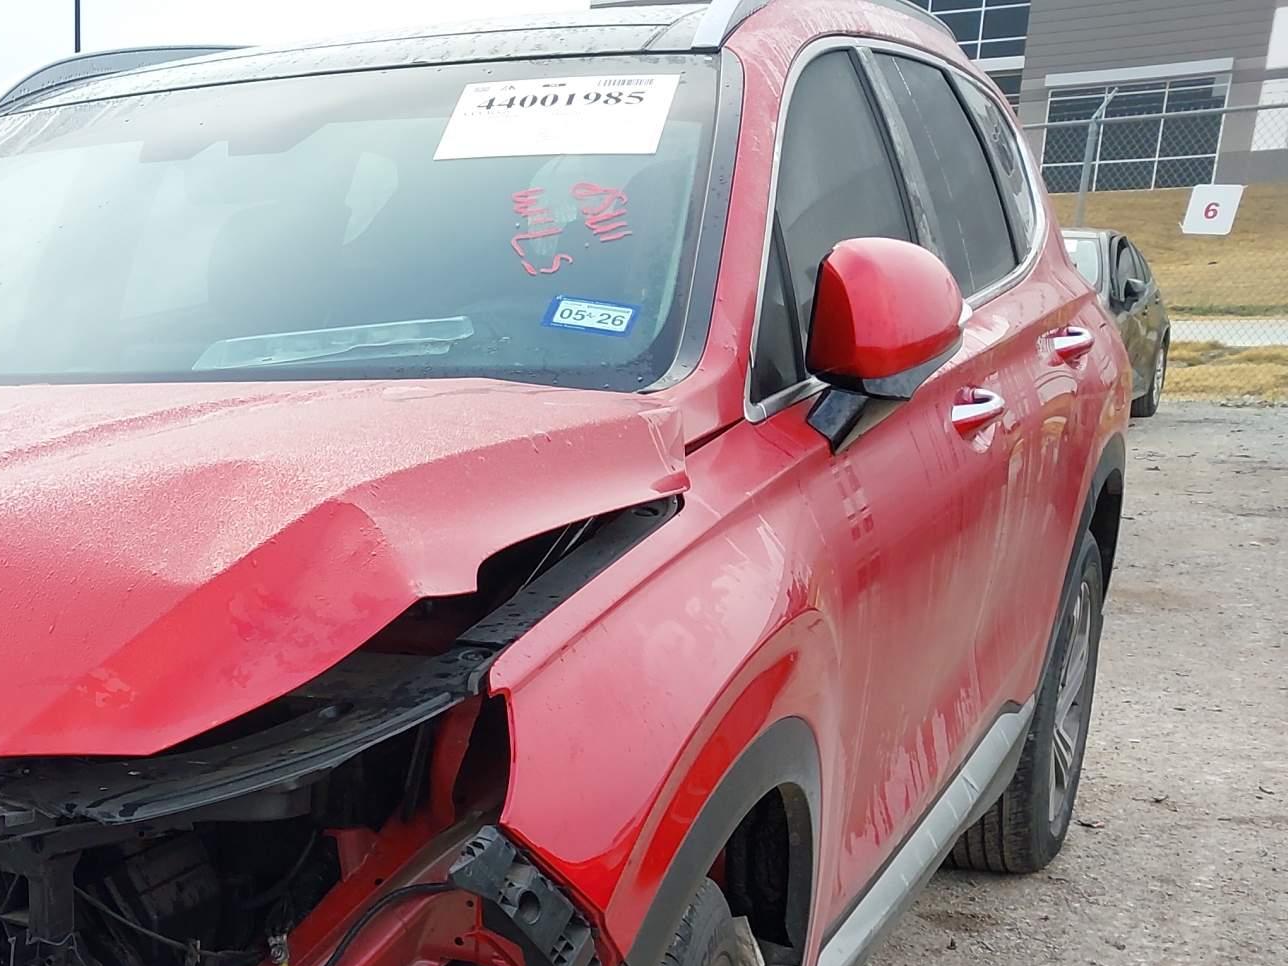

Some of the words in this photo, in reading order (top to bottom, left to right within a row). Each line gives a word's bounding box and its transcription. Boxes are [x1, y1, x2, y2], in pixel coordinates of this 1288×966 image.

[476, 91, 646, 110] 44001985
[1204, 202, 1220, 219] 6
[559, 308, 587, 321] 05
[597, 313, 626, 326] 26
